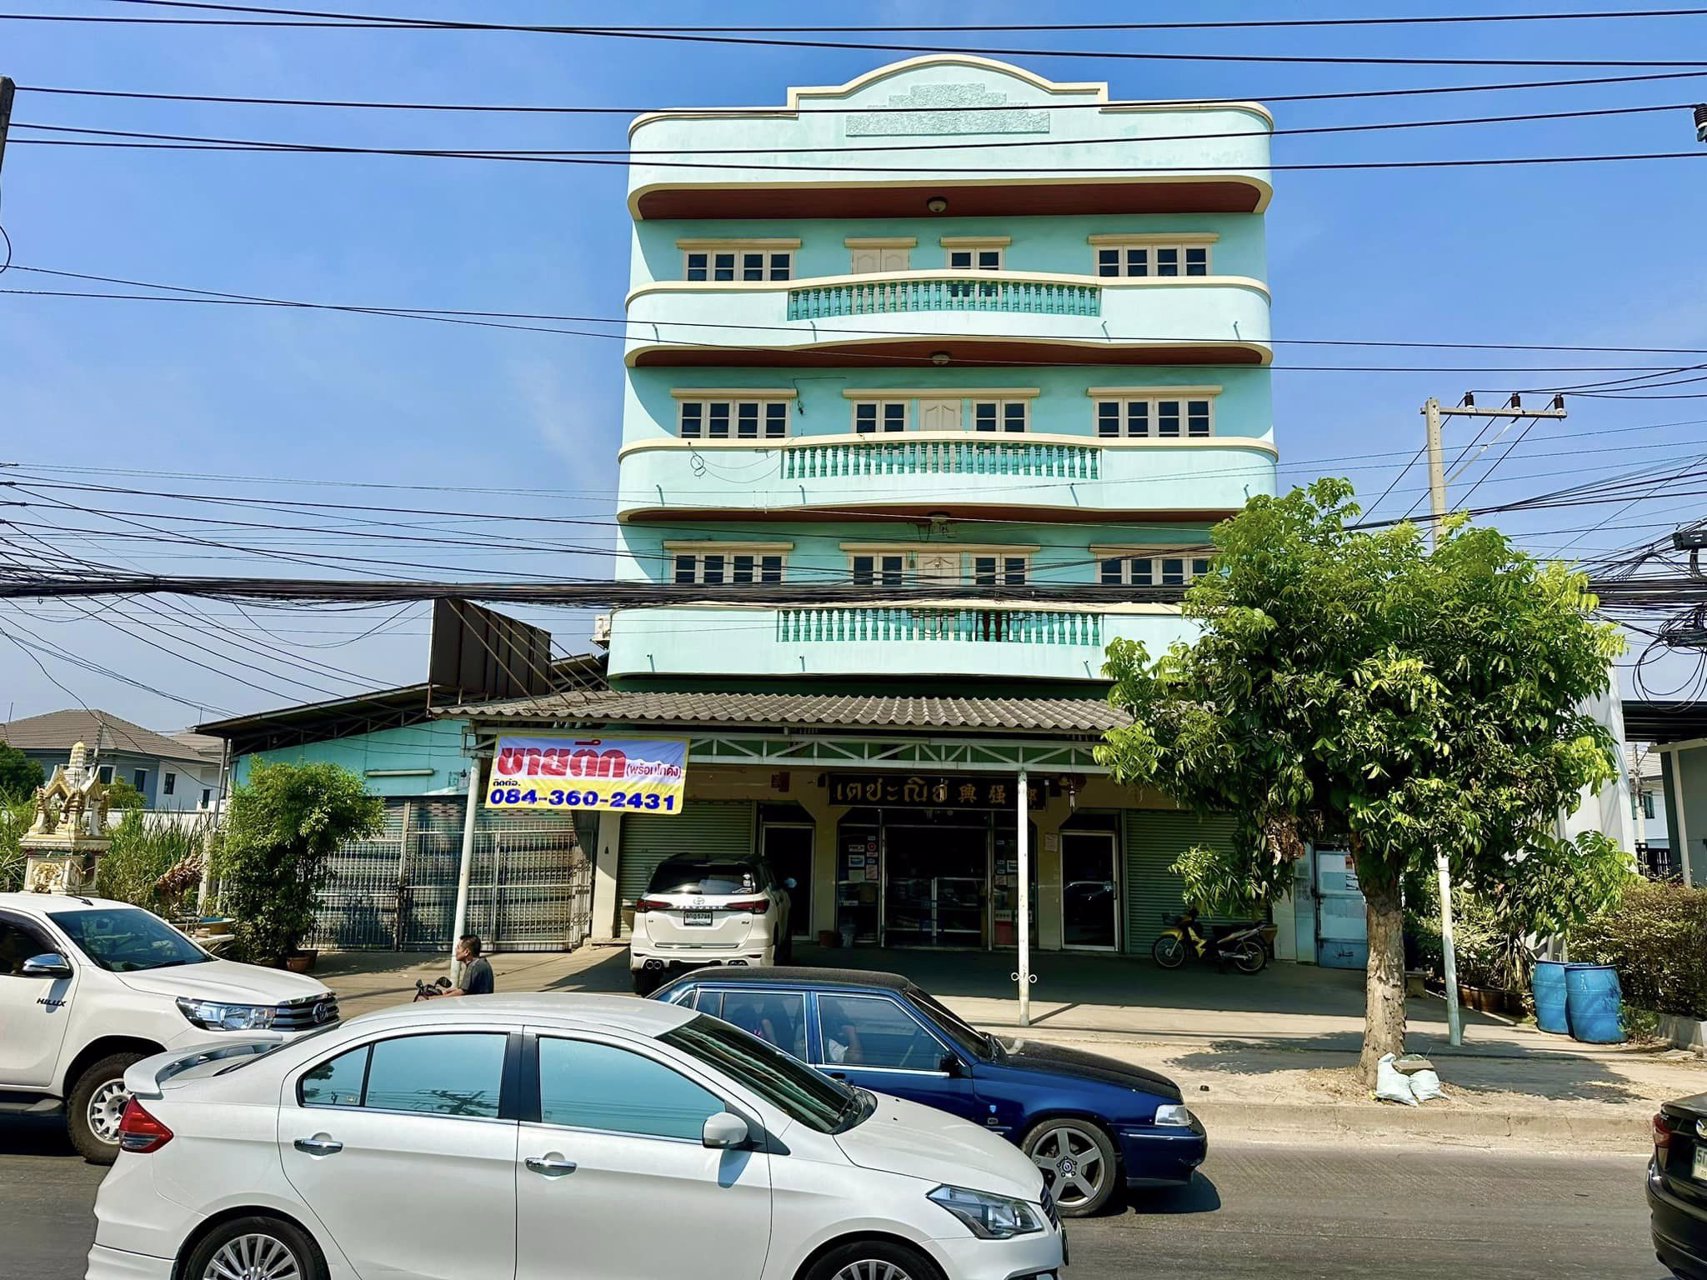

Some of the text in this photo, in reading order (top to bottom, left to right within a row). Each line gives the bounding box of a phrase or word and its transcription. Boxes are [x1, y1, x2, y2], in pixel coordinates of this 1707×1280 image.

[497, 739, 627, 778] ขายตึก
[490, 788, 675, 811] 084-360-2431
[36, 997, 67, 1007] HILUX
